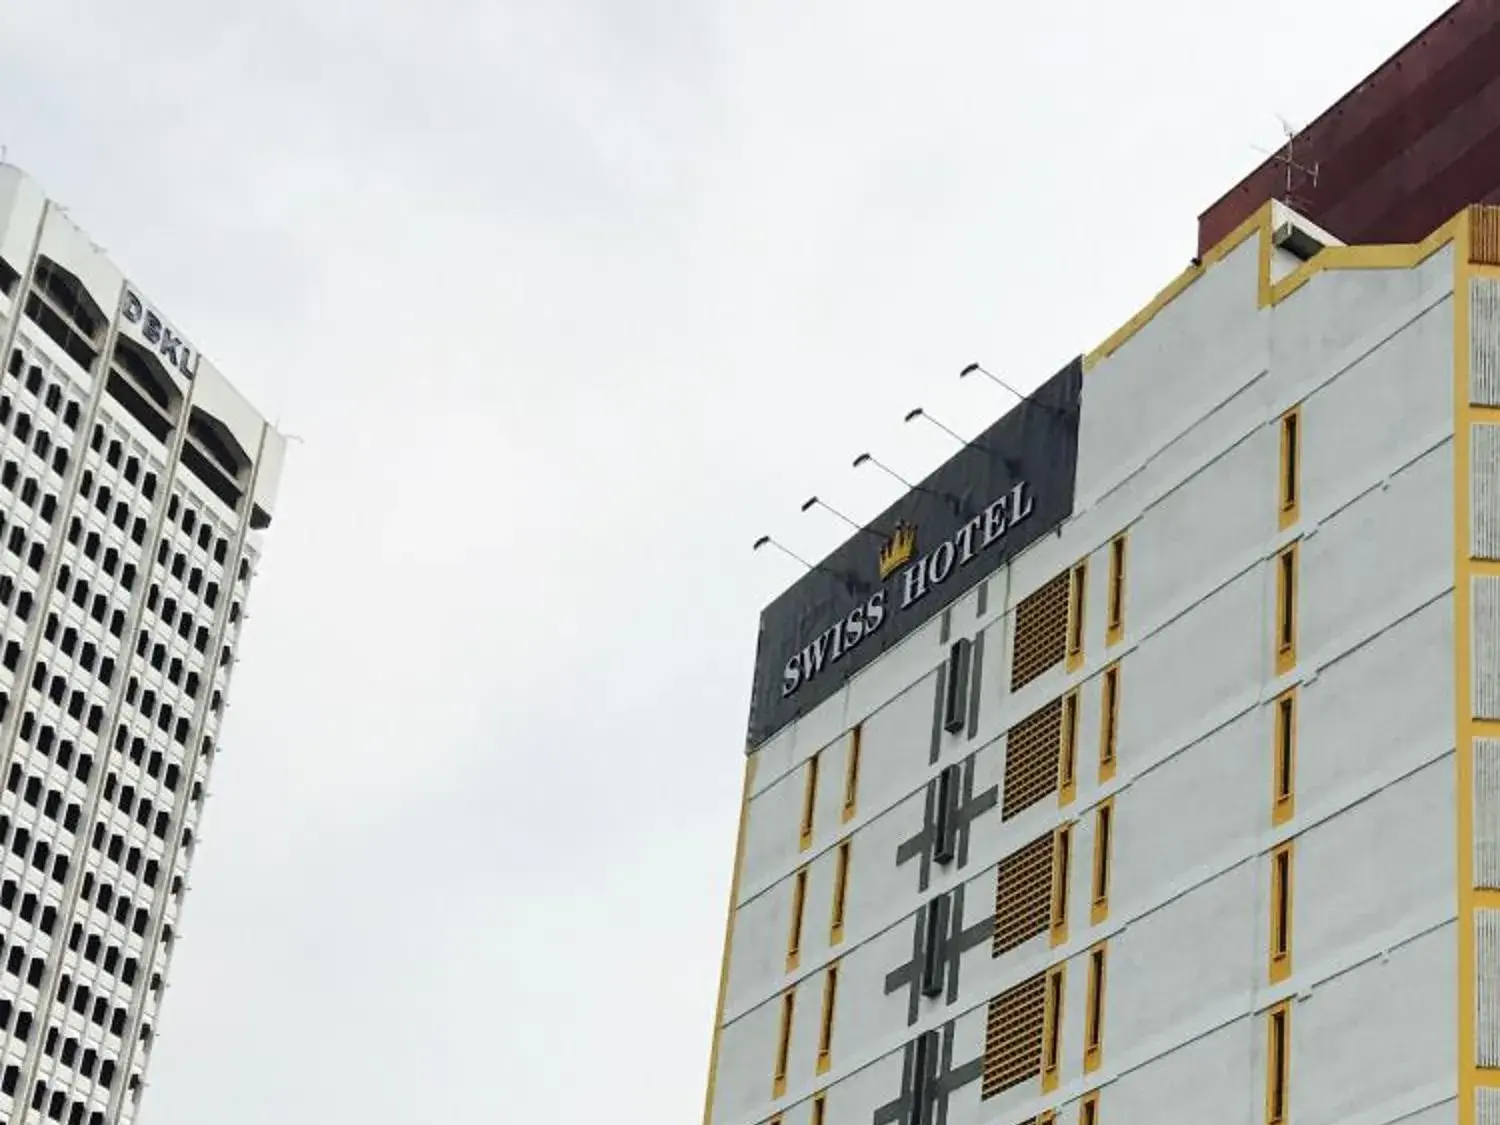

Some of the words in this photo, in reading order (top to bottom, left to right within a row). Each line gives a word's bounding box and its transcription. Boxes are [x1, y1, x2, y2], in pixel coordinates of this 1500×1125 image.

[122, 289, 194, 381] DBKL
[782, 587, 886, 696] SWISS
[900, 480, 1034, 609] HOTEL
